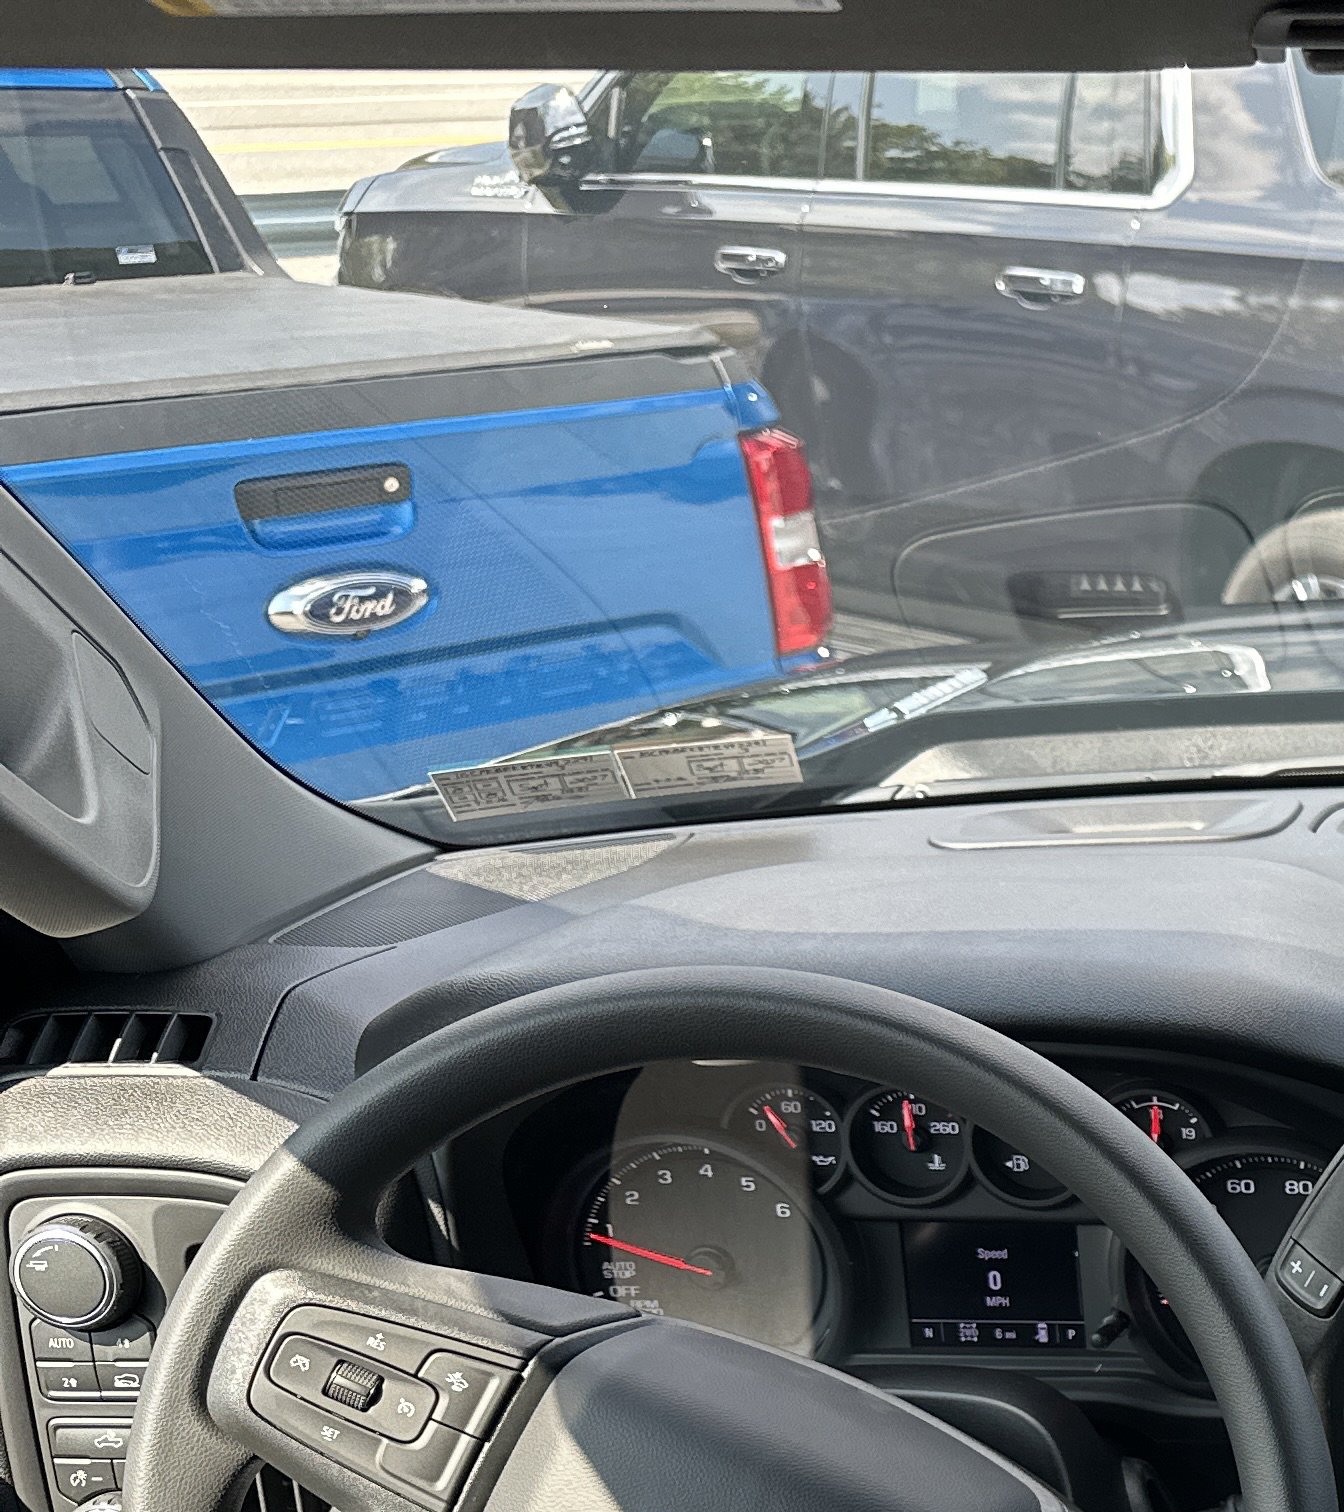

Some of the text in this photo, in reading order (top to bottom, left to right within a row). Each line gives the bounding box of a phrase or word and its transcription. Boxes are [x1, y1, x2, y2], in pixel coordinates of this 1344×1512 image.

[329, 586, 397, 623] Ford
[780, 1101, 802, 1114] 60
[754, 1118, 767, 1132] 0
[810, 1120, 836, 1133] 120
[873, 1121, 898, 1133] 160
[929, 1121, 960, 1135] 260
[1181, 1127, 1196, 1140] 19
[656, 1170, 673, 1185] 3
[698, 1163, 714, 1178] 4
[740, 1177, 756, 1192] 5
[1226, 1178, 1255, 1195] 60
[1284, 1179, 1313, 1195] 80
[624, 1191, 640, 1206] 2
[775, 1203, 792, 1218] 6
[977, 1248, 1009, 1260] Speed
[602, 1261, 636, 1270] AUTO
[987, 1270, 1002, 1290] 0
[609, 1285, 641, 1297] OFF
[985, 1296, 1010, 1307] MPH
[1067, 1329, 1076, 1340] P
[48, 1338, 75, 1349] AUTO
